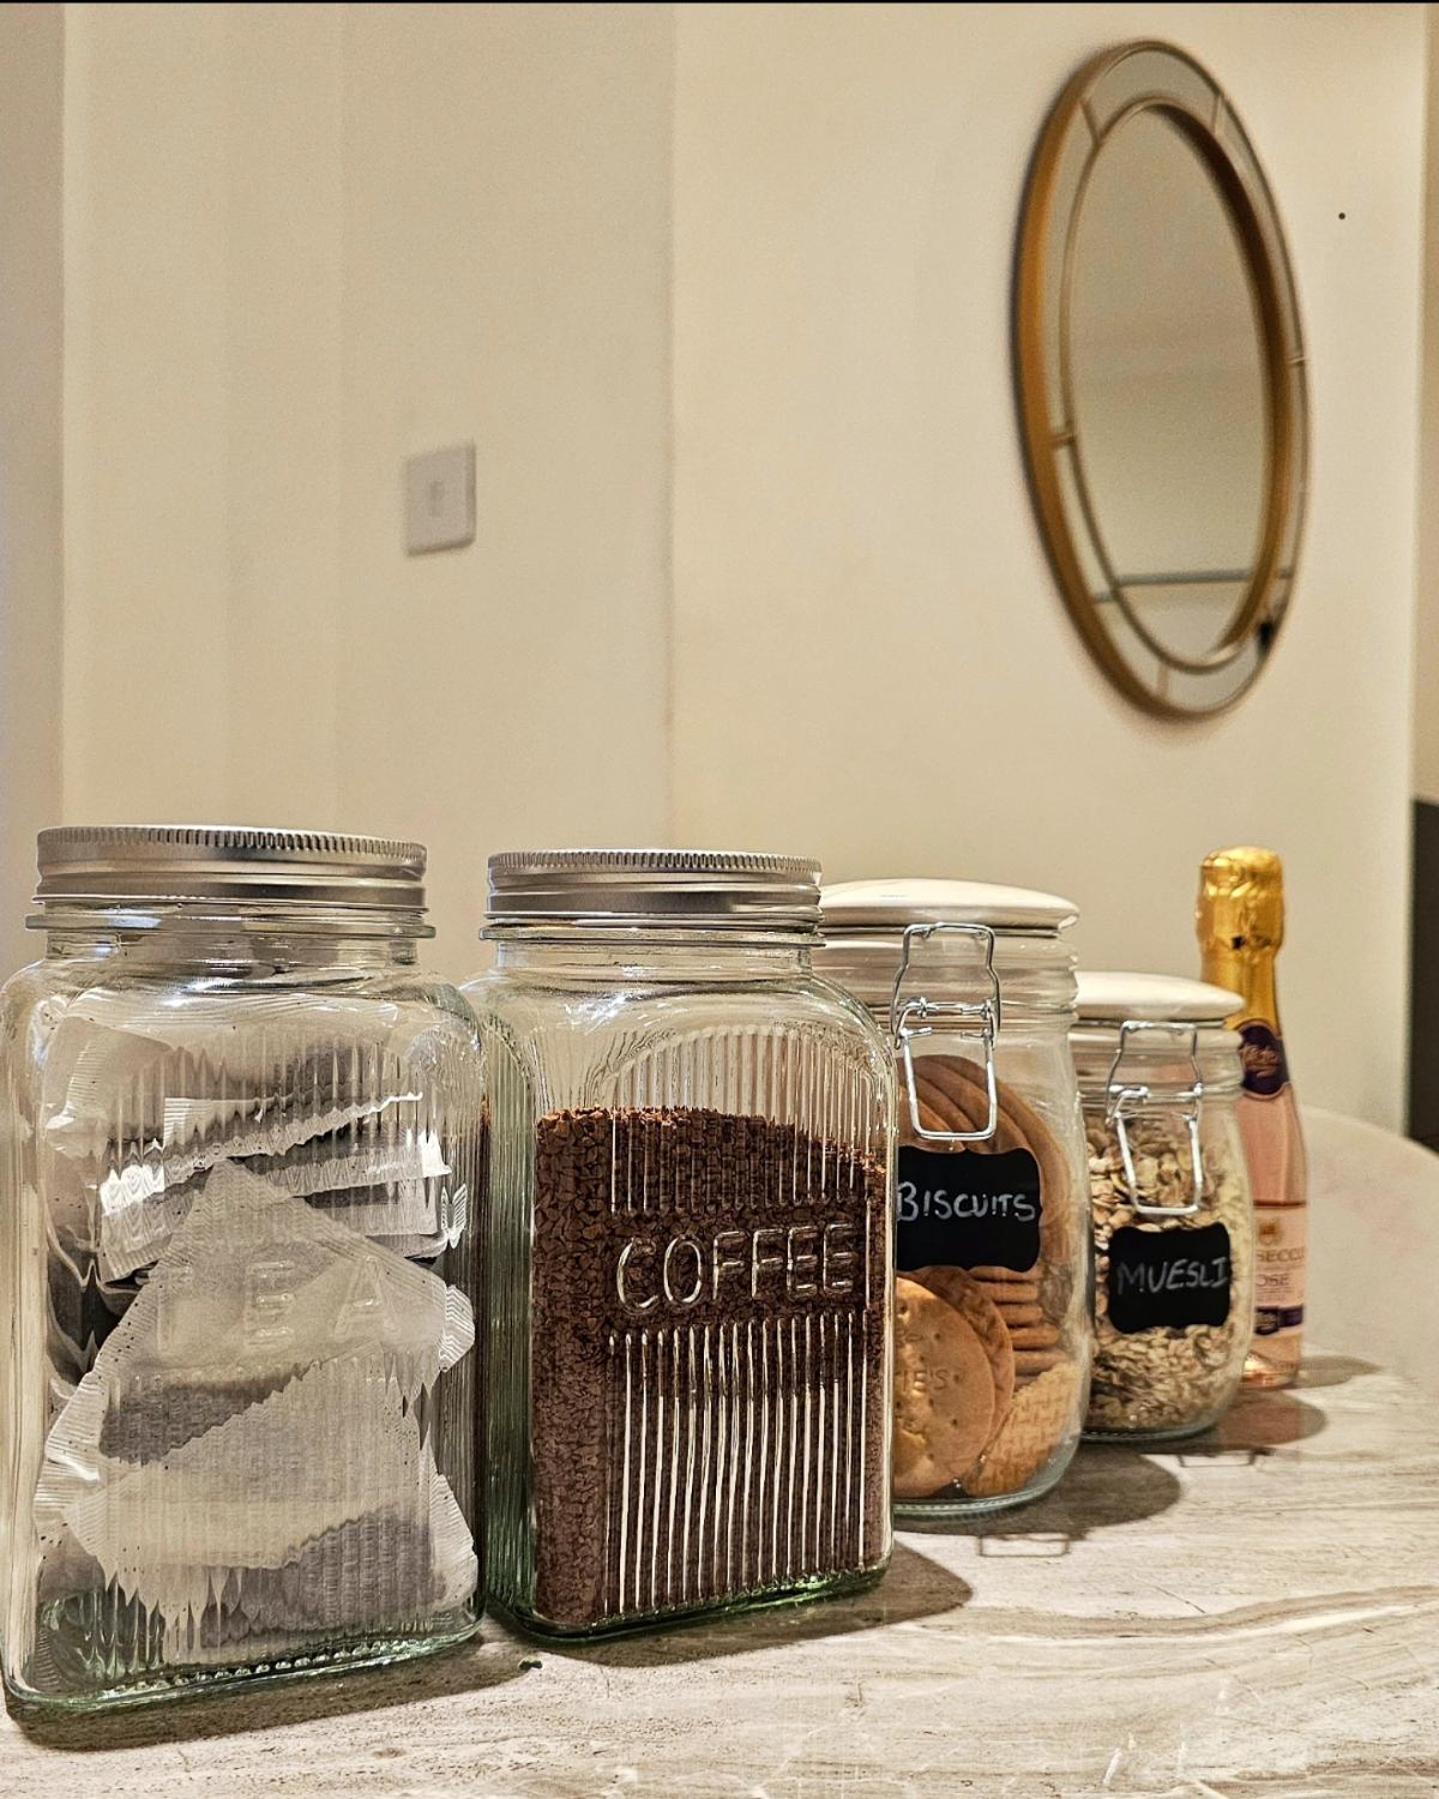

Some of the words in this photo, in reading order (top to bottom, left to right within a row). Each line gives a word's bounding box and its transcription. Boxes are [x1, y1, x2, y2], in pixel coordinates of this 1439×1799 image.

[896, 1181, 1036, 1222] BISCUITS
[616, 1223, 853, 1314] COFFEE
[1116, 1256, 1228, 1295] MUESLI
